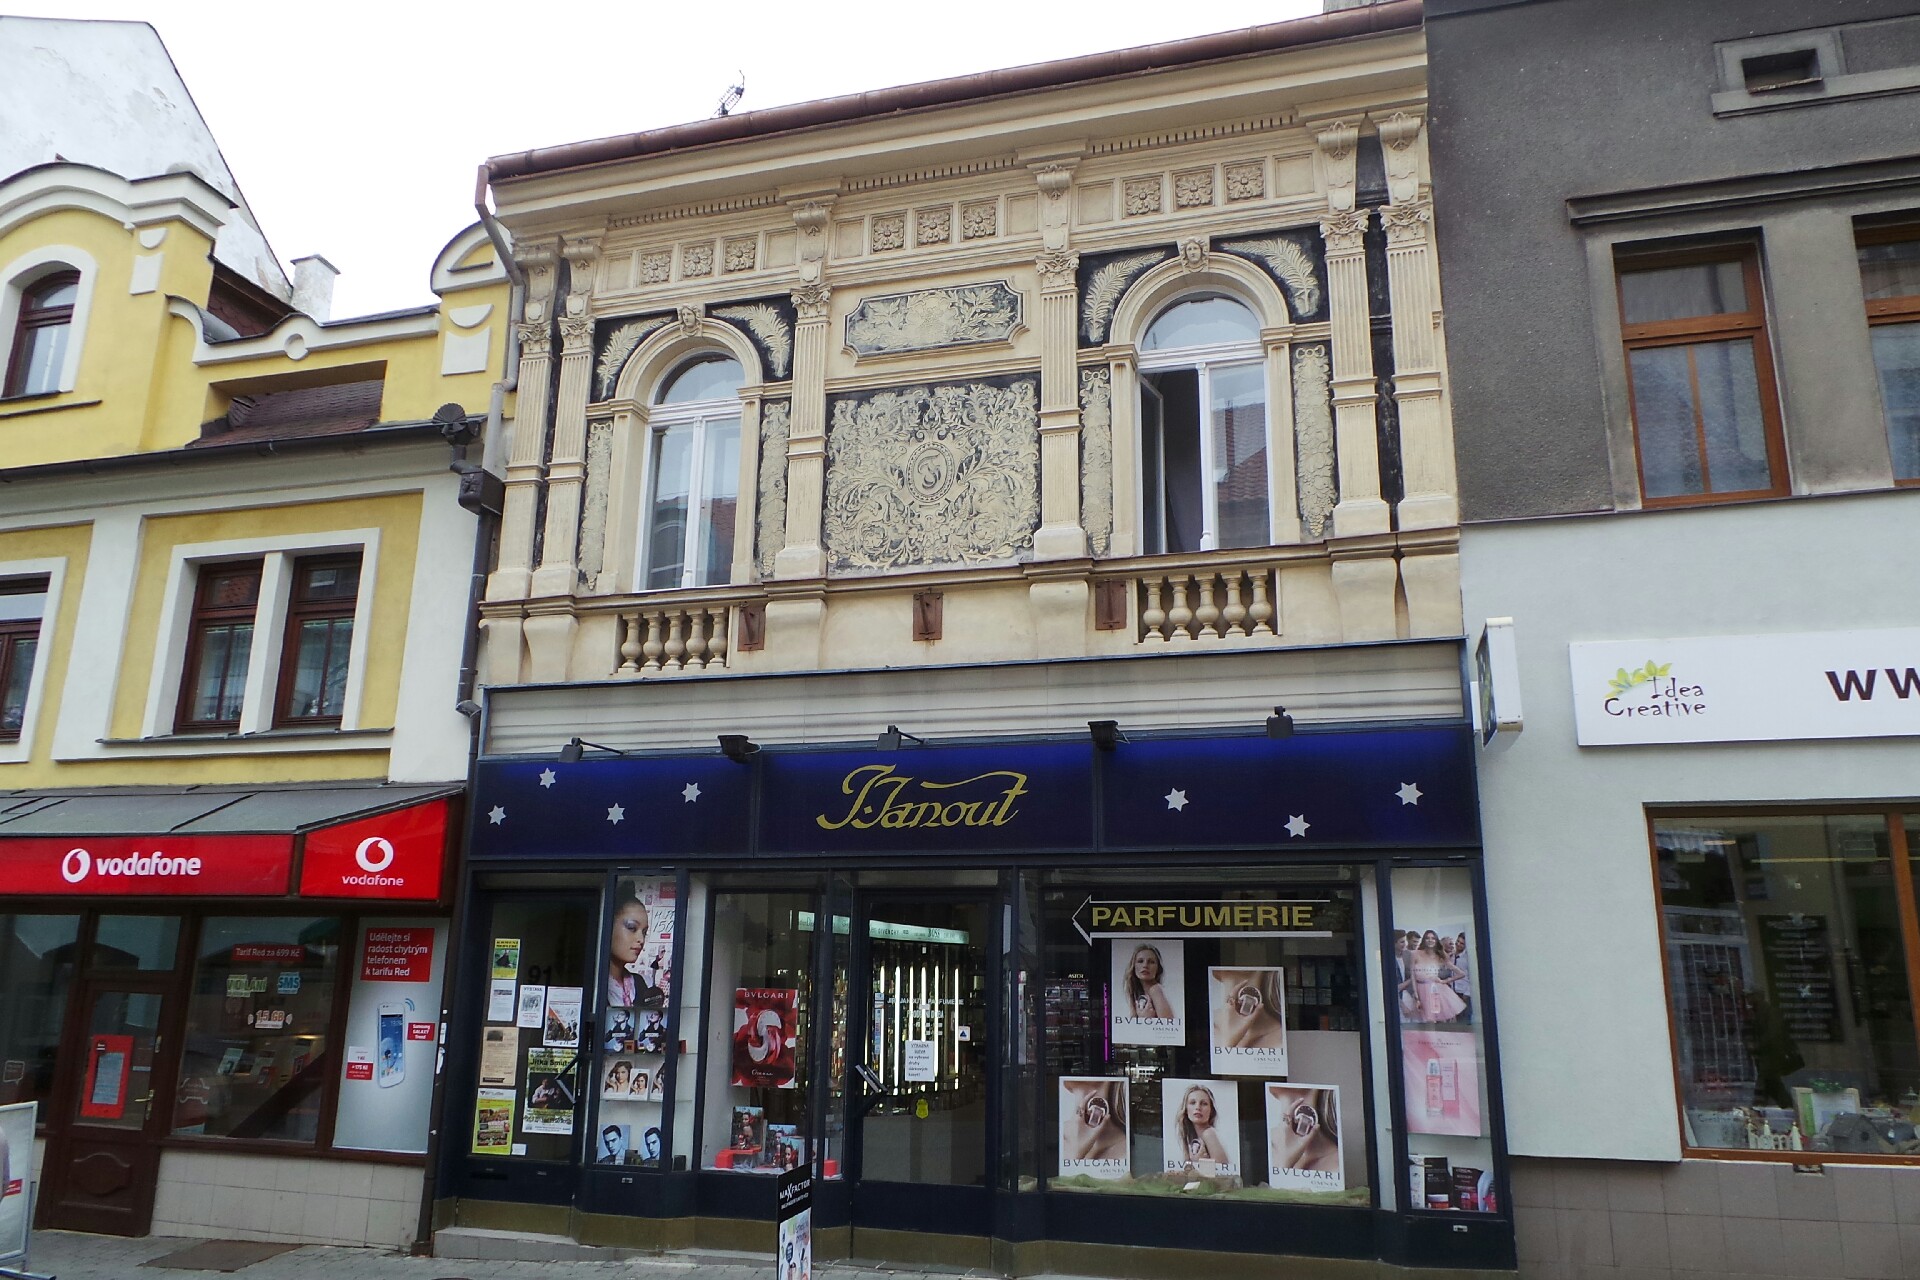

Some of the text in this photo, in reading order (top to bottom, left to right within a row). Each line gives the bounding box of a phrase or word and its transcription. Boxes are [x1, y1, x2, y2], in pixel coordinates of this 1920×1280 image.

[1646, 676, 1704, 699] Idea
[1604, 697, 1706, 717] Creative
[96, 851, 202, 876] vodafone
[341, 874, 405, 886] vodafone
[1092, 906, 1314, 927] PARFUMERIE
[369, 933, 411, 944] Udělejte si
[235, 947, 251, 956] Tarif
[252, 948, 265, 956] Red
[276, 949, 290, 957] 699
[368, 945, 428, 956] radost chytrým
[367, 956, 407, 965] telefonem
[365, 967, 410, 976] k tarifu Red
[277, 976, 300, 989] SMS
[1114, 1016, 1182, 1025] BVLGARI
[1214, 1046, 1284, 1056] BVLGARI
[1063, 1158, 1127, 1167] BVLGARI
[1167, 1160, 1237, 1171] BVRI
[1272, 1166, 1341, 1180] BVLGARI
